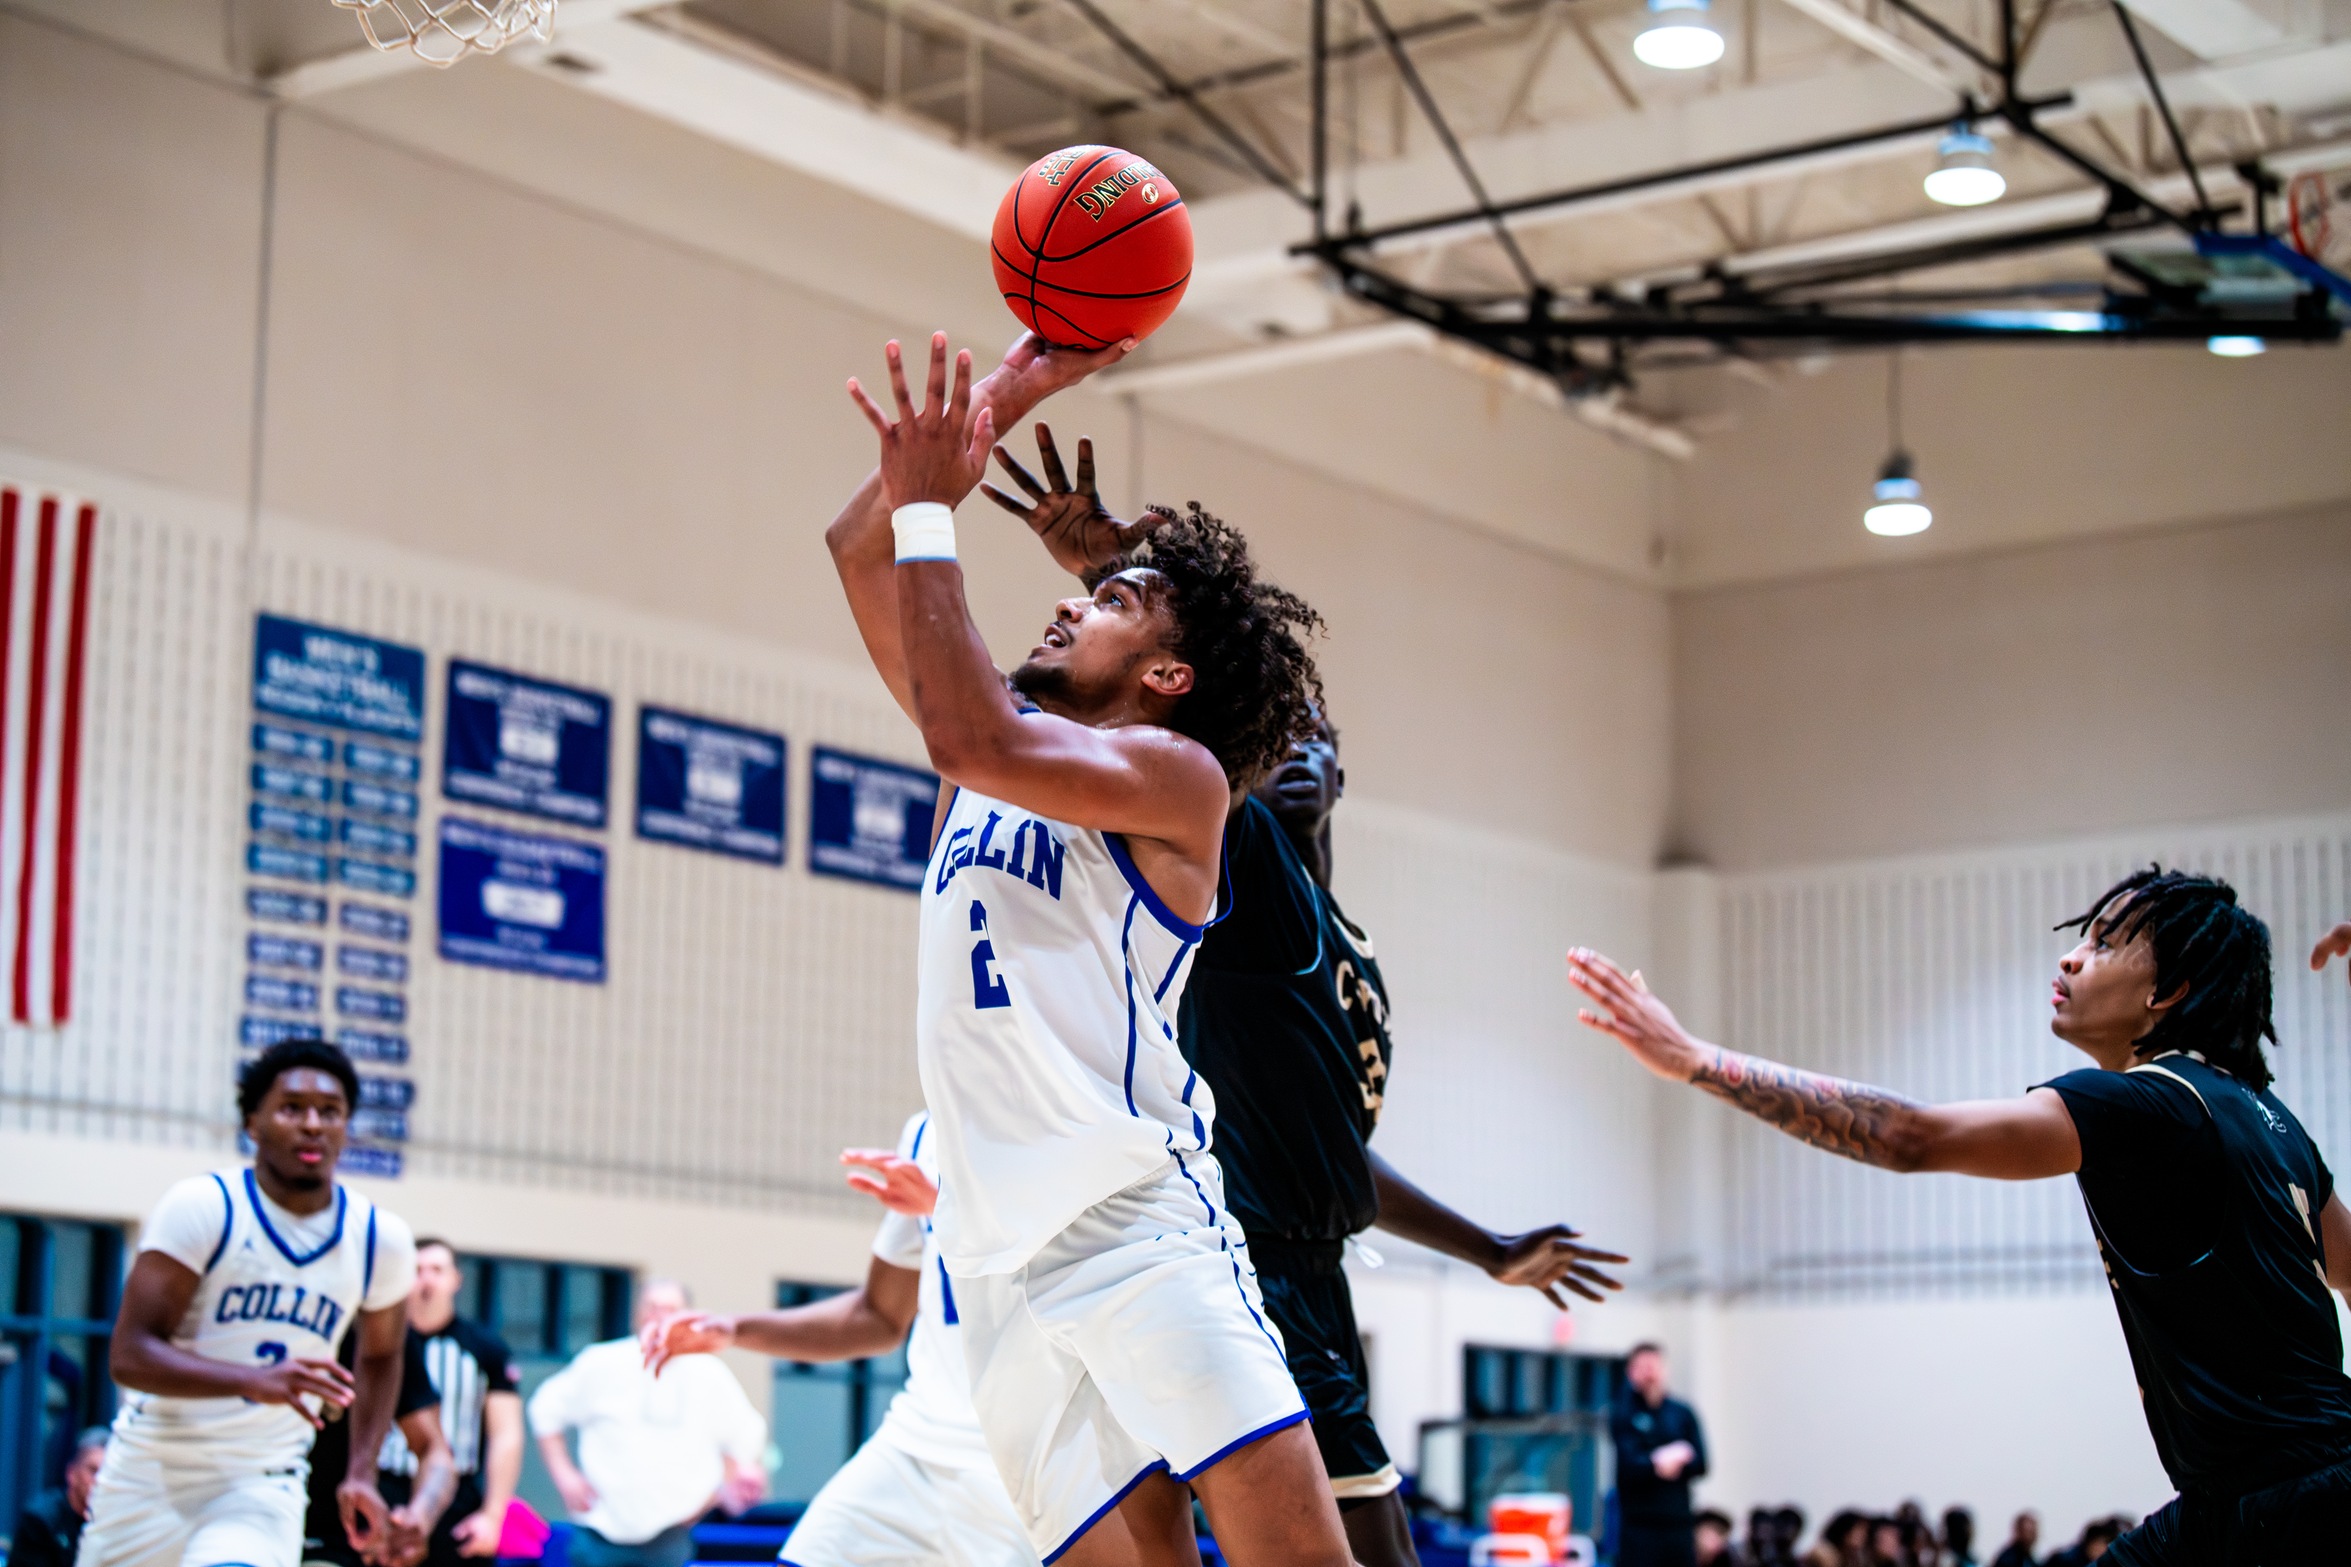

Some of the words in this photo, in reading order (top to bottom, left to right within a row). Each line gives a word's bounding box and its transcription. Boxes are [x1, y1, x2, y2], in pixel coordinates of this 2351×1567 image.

[935, 810, 1066, 901] CLLIN
[969, 900, 1012, 1010] 2
[215, 1282, 344, 1342] COLLIN
